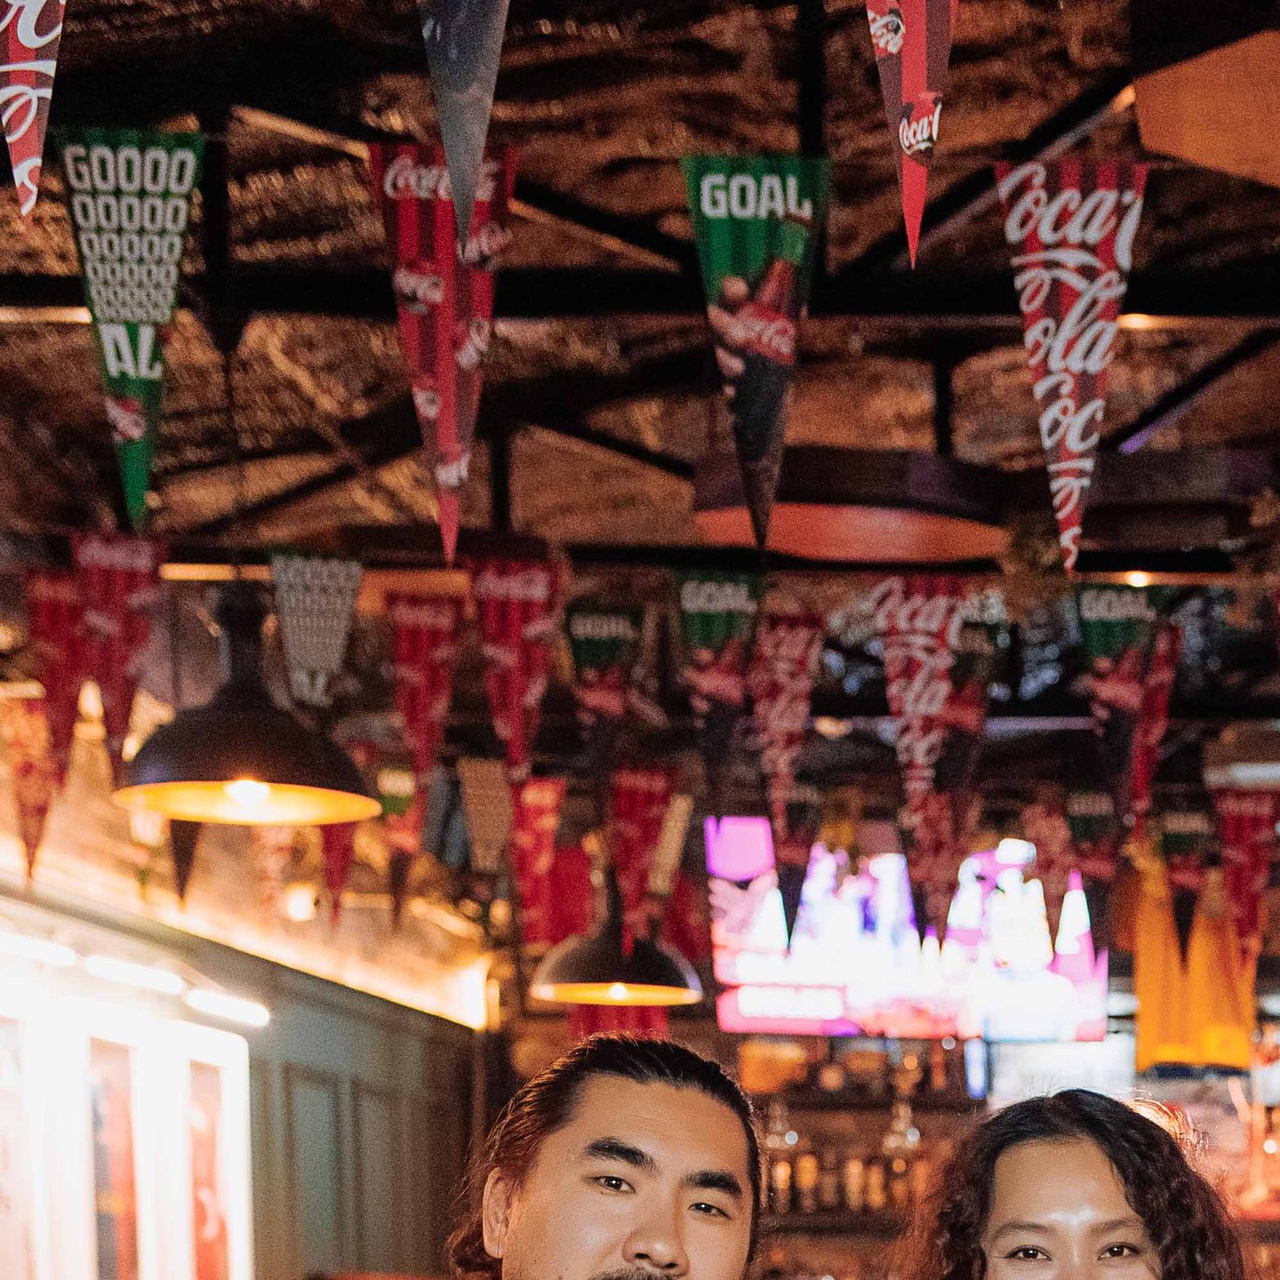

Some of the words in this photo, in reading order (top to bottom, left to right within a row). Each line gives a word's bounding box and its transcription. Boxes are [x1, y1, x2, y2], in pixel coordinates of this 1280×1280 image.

[64, 145, 196, 194] GOOOO
[700, 173, 813, 221] GOAL
[99, 323, 162, 379] AL
